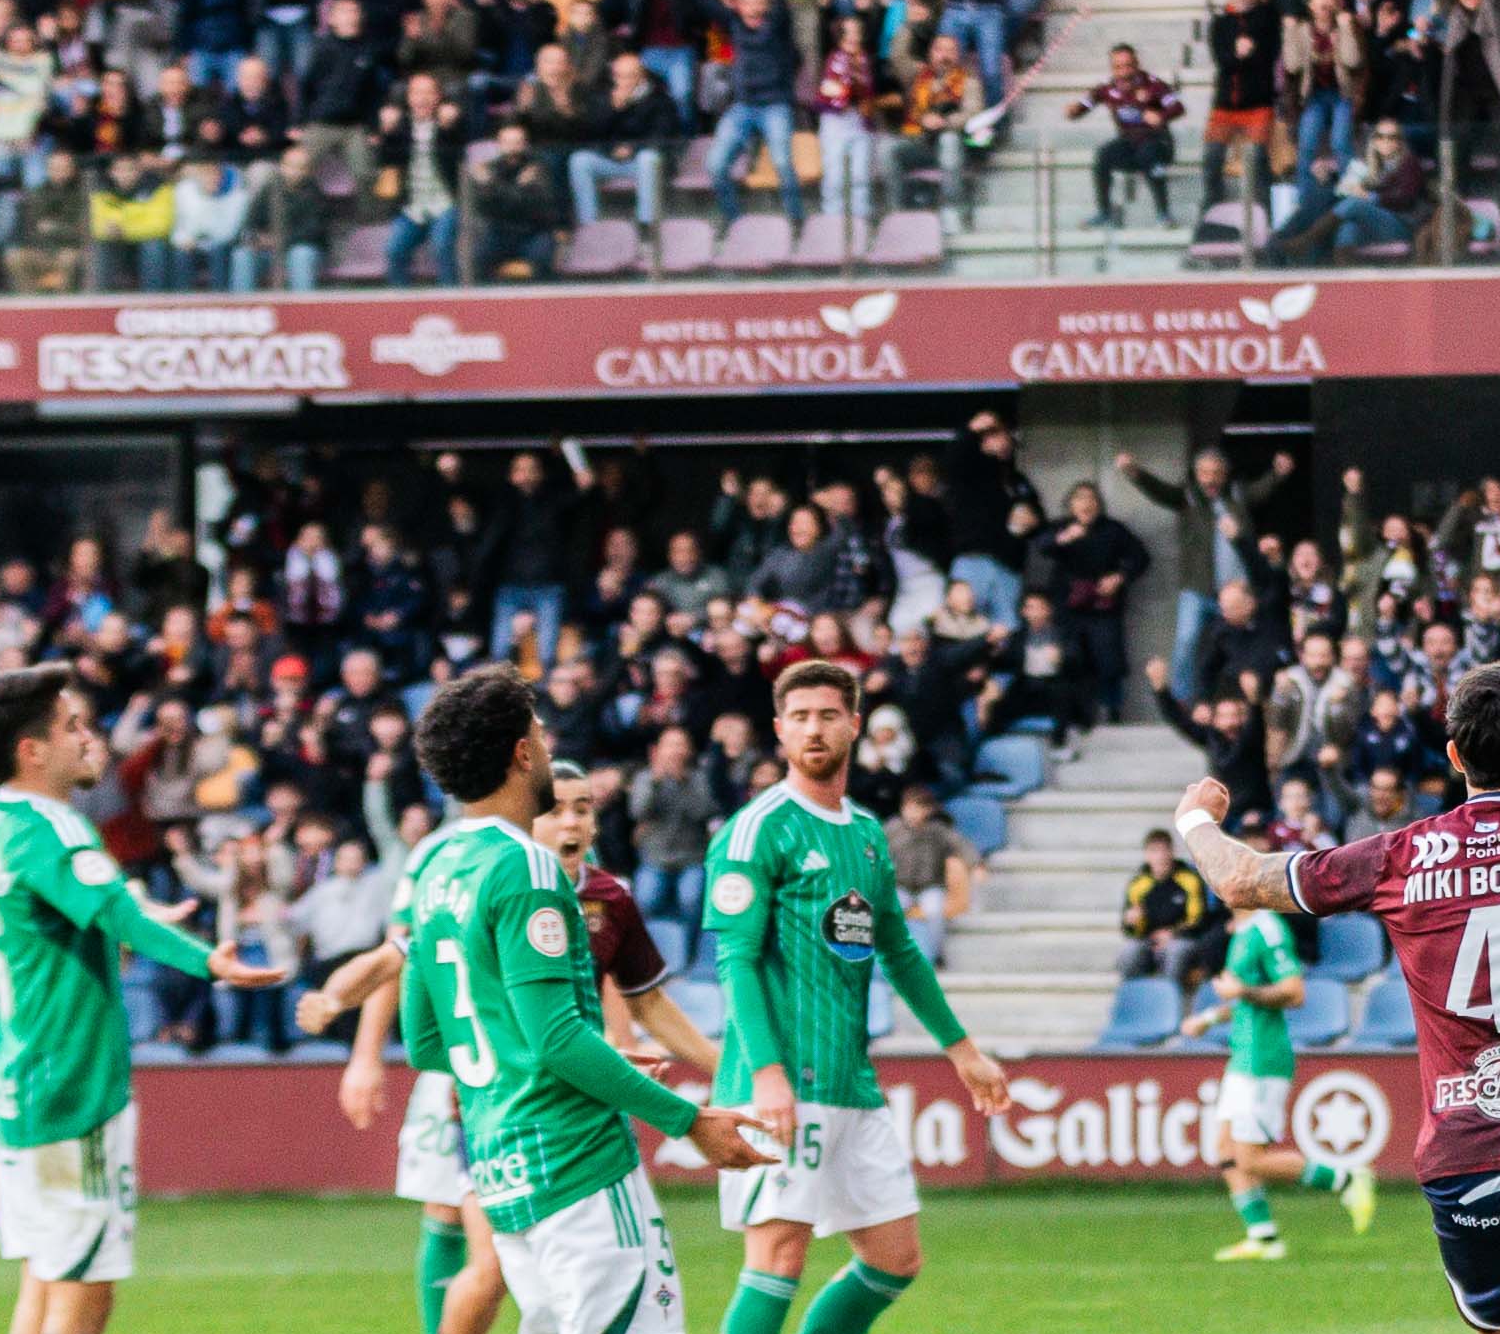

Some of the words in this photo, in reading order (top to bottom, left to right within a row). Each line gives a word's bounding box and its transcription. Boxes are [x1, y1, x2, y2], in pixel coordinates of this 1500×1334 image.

[642, 321, 724, 341] HOTEL
[1059, 312, 1142, 334] HOTEL
[1154, 310, 1240, 332] RURAL
[39, 334, 350, 391] PESCAMAR
[594, 343, 905, 387] CAMPANIOLA
[1010, 336, 1327, 379] CAMPANIOLA
[1403, 867, 1463, 905] MIKI
[434, 938, 496, 1088] 3
[990, 1077, 1219, 1169] Galici
[649, 1217, 674, 1276] 3
